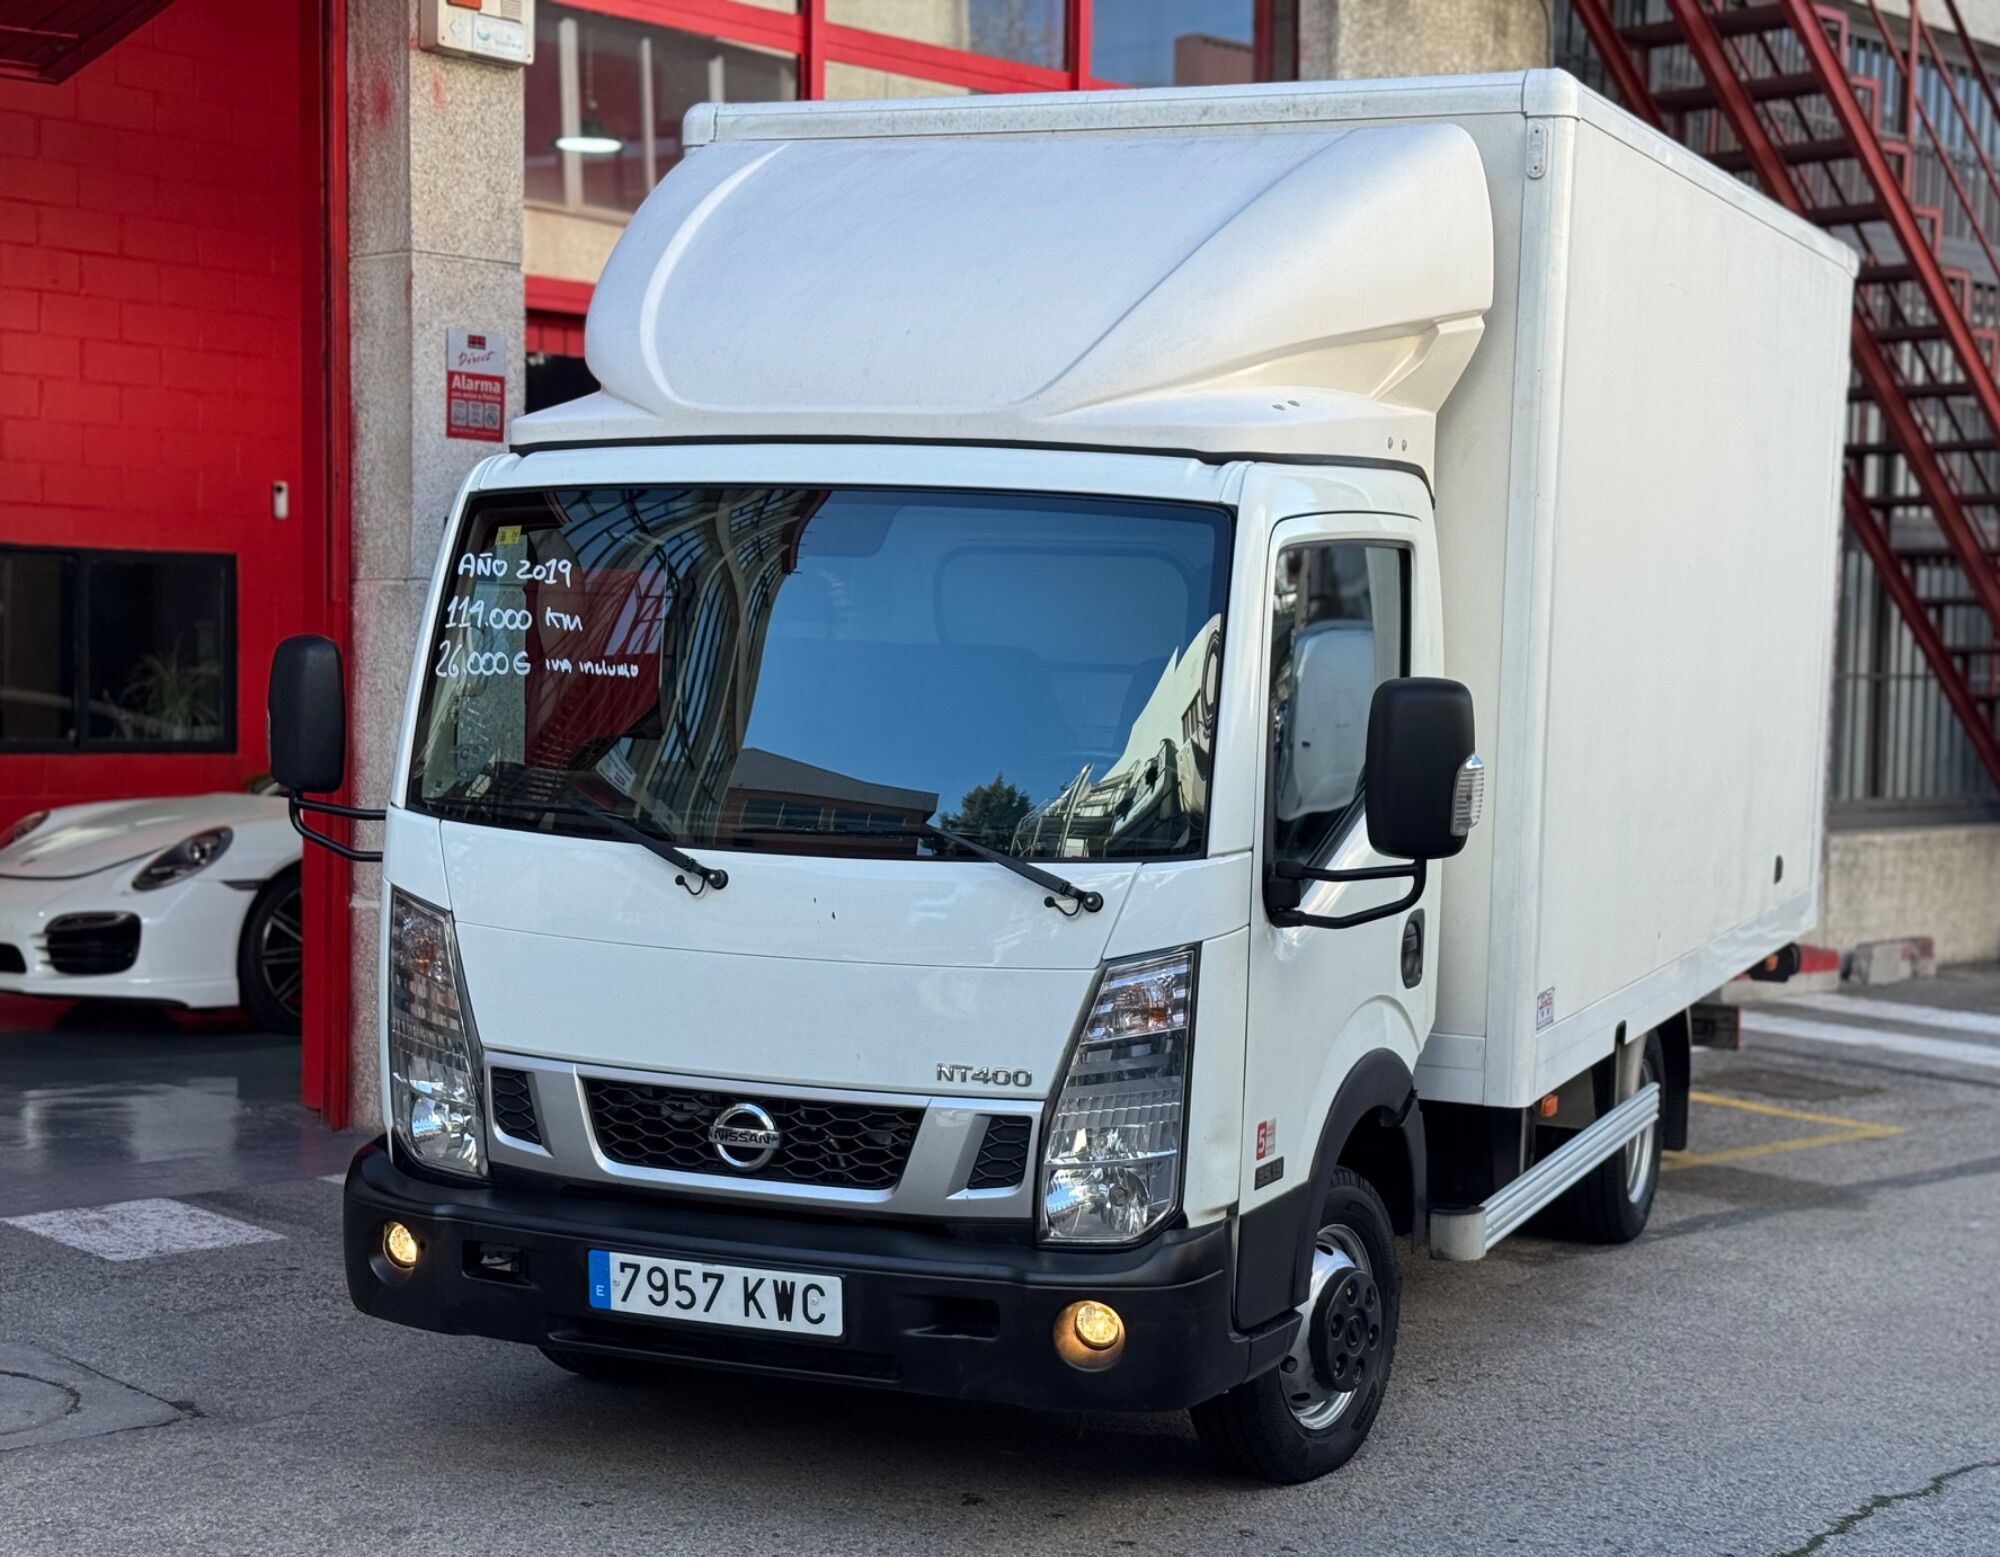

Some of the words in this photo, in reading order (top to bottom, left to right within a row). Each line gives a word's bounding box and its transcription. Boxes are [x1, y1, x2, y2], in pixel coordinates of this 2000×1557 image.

[451, 374, 501, 394] Alarma
[458, 553, 508, 578] AÑO
[516, 559, 572, 588] 2019
[936, 1062, 1033, 1087] NT400
[714, 1126, 771, 1145] NISSAN
[596, 1285, 605, 1297] E
[619, 1261, 725, 1313] 7957
[742, 1275, 826, 1325] KWC
